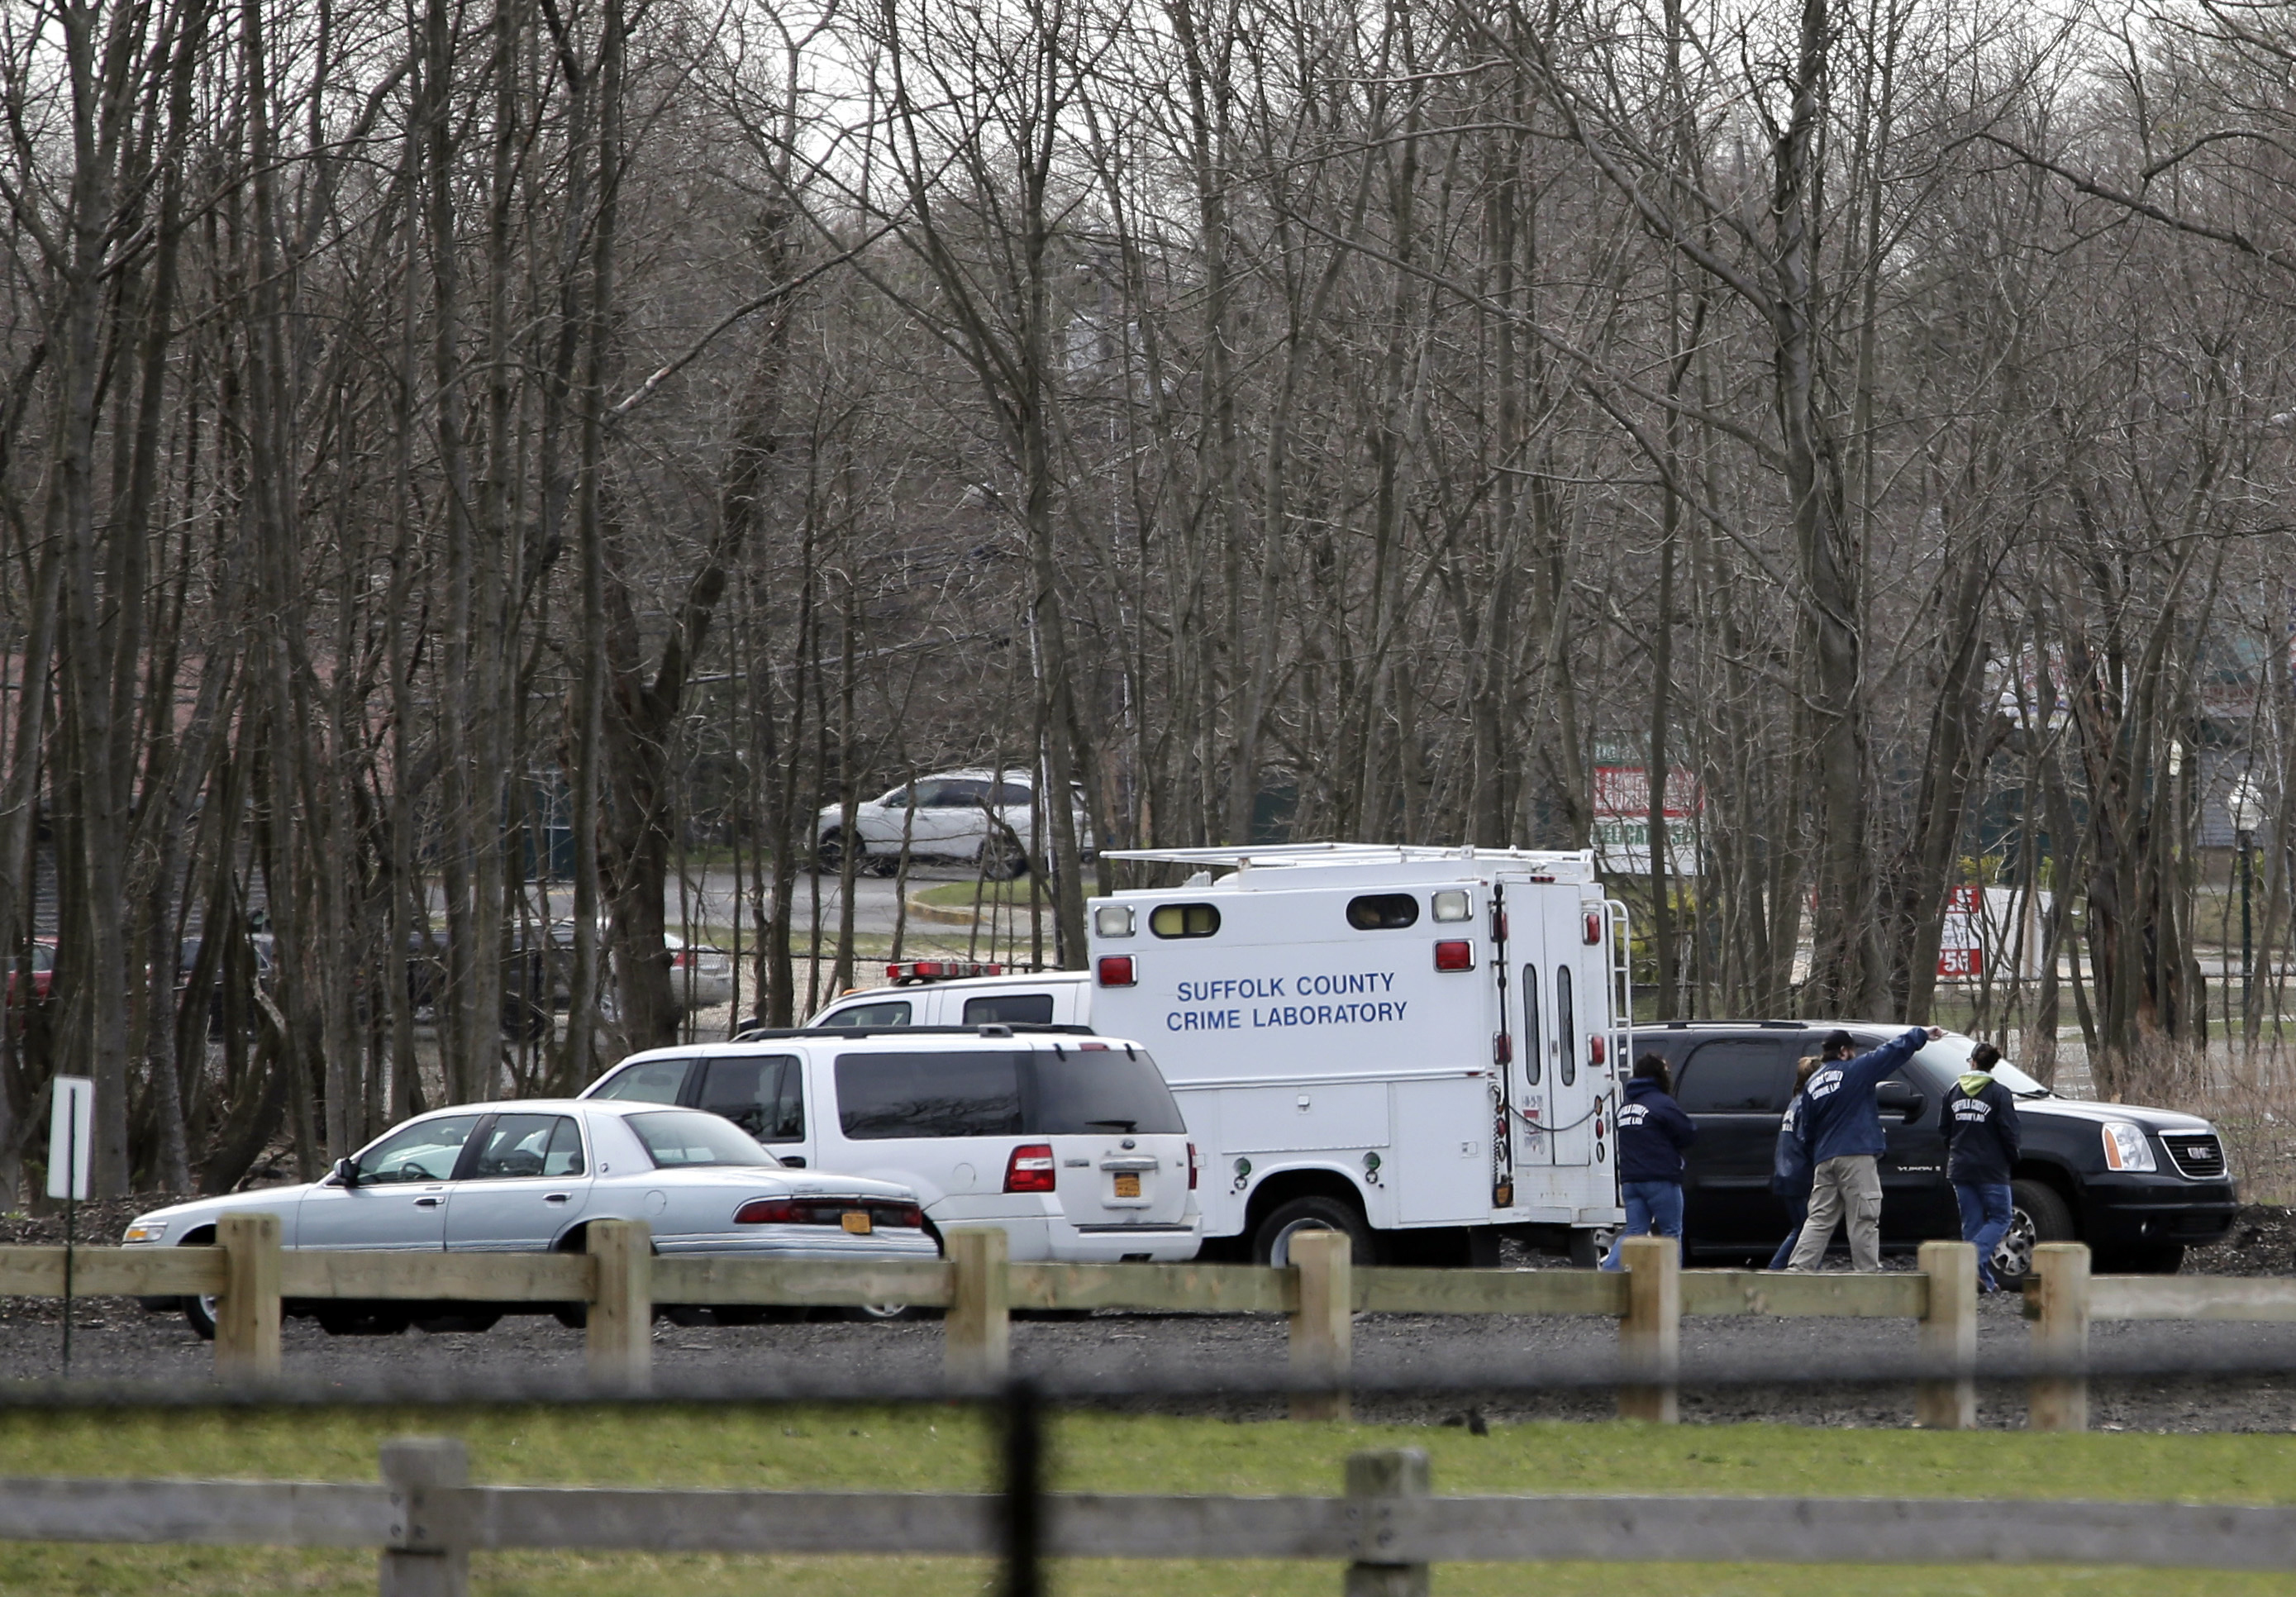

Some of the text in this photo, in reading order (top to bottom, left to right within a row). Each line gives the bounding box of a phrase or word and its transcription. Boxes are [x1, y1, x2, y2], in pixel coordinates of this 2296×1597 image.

[1177, 972, 1395, 1002] SUFFOLK COUNTY
[1166, 1001, 1408, 1032] CRIME LABORATORY
